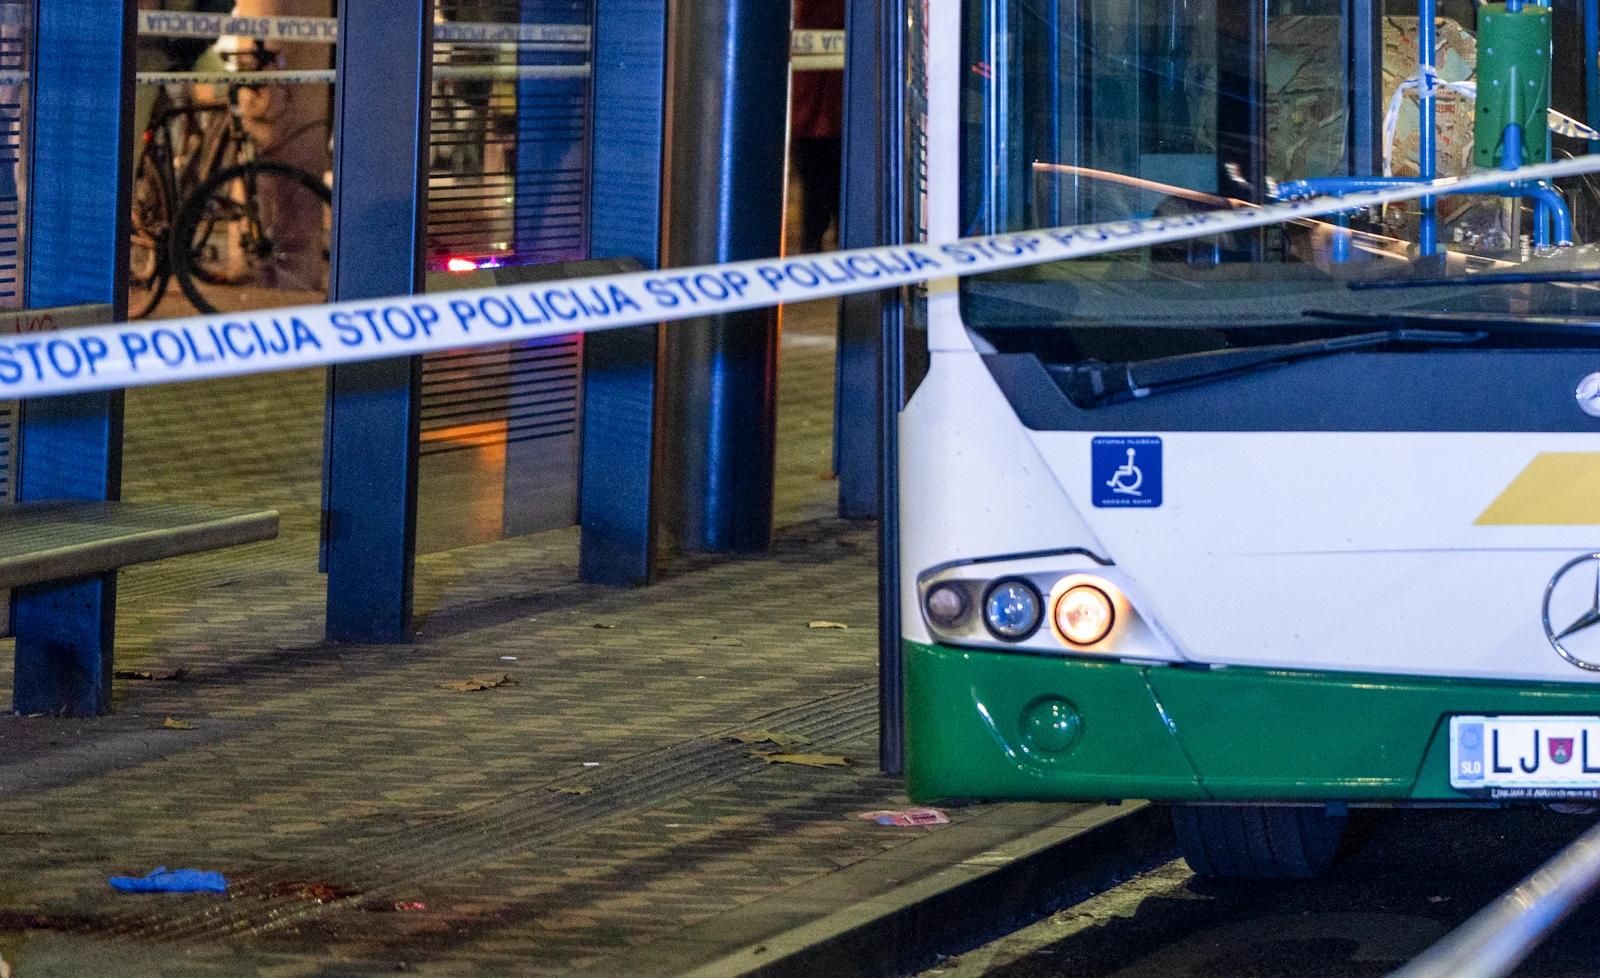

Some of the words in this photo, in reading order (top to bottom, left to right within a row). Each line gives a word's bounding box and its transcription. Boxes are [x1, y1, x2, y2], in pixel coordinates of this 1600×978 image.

[0, 335, 109, 385] STOP
[120, 316, 323, 371] POLICIJA
[330, 302, 439, 347] STOP
[450, 284, 641, 334] POLICIJA
[644, 270, 749, 308] STOP
[756, 249, 942, 293] POLICIJA
[941, 235, 1040, 266] STOP
[1460, 760, 1481, 774] SLO
[1491, 728, 1541, 774] LJ
